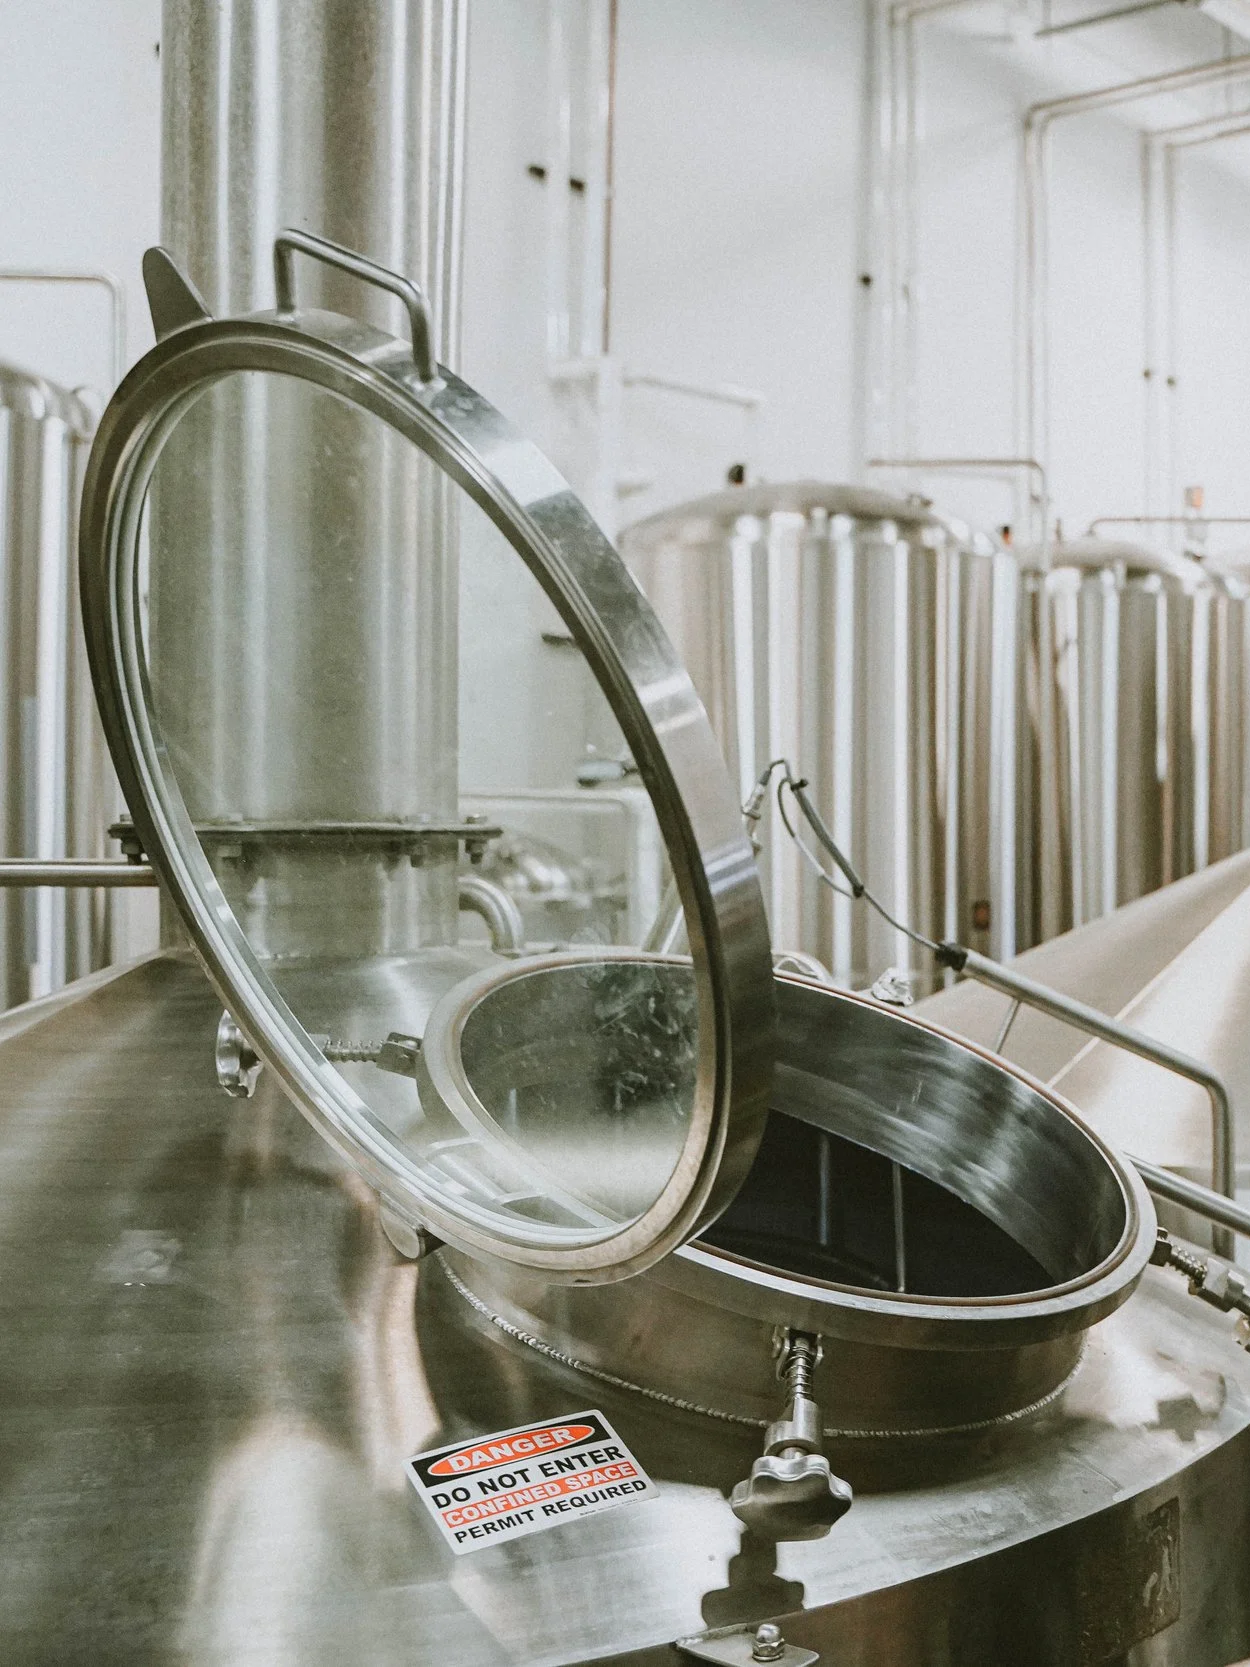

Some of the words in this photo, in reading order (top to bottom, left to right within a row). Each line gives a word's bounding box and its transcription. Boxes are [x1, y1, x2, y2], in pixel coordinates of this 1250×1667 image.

[431, 1487, 470, 1509] DO
[477, 1468, 531, 1495] NOT
[539, 1446, 625, 1477] ENTER
[448, 1428, 575, 1472] DANGER
[445, 1482, 563, 1526] CONFINED
[568, 1464, 635, 1490] SPACE
[454, 1509, 534, 1543] PERMIT
[542, 1480, 647, 1516] REQUIRED
